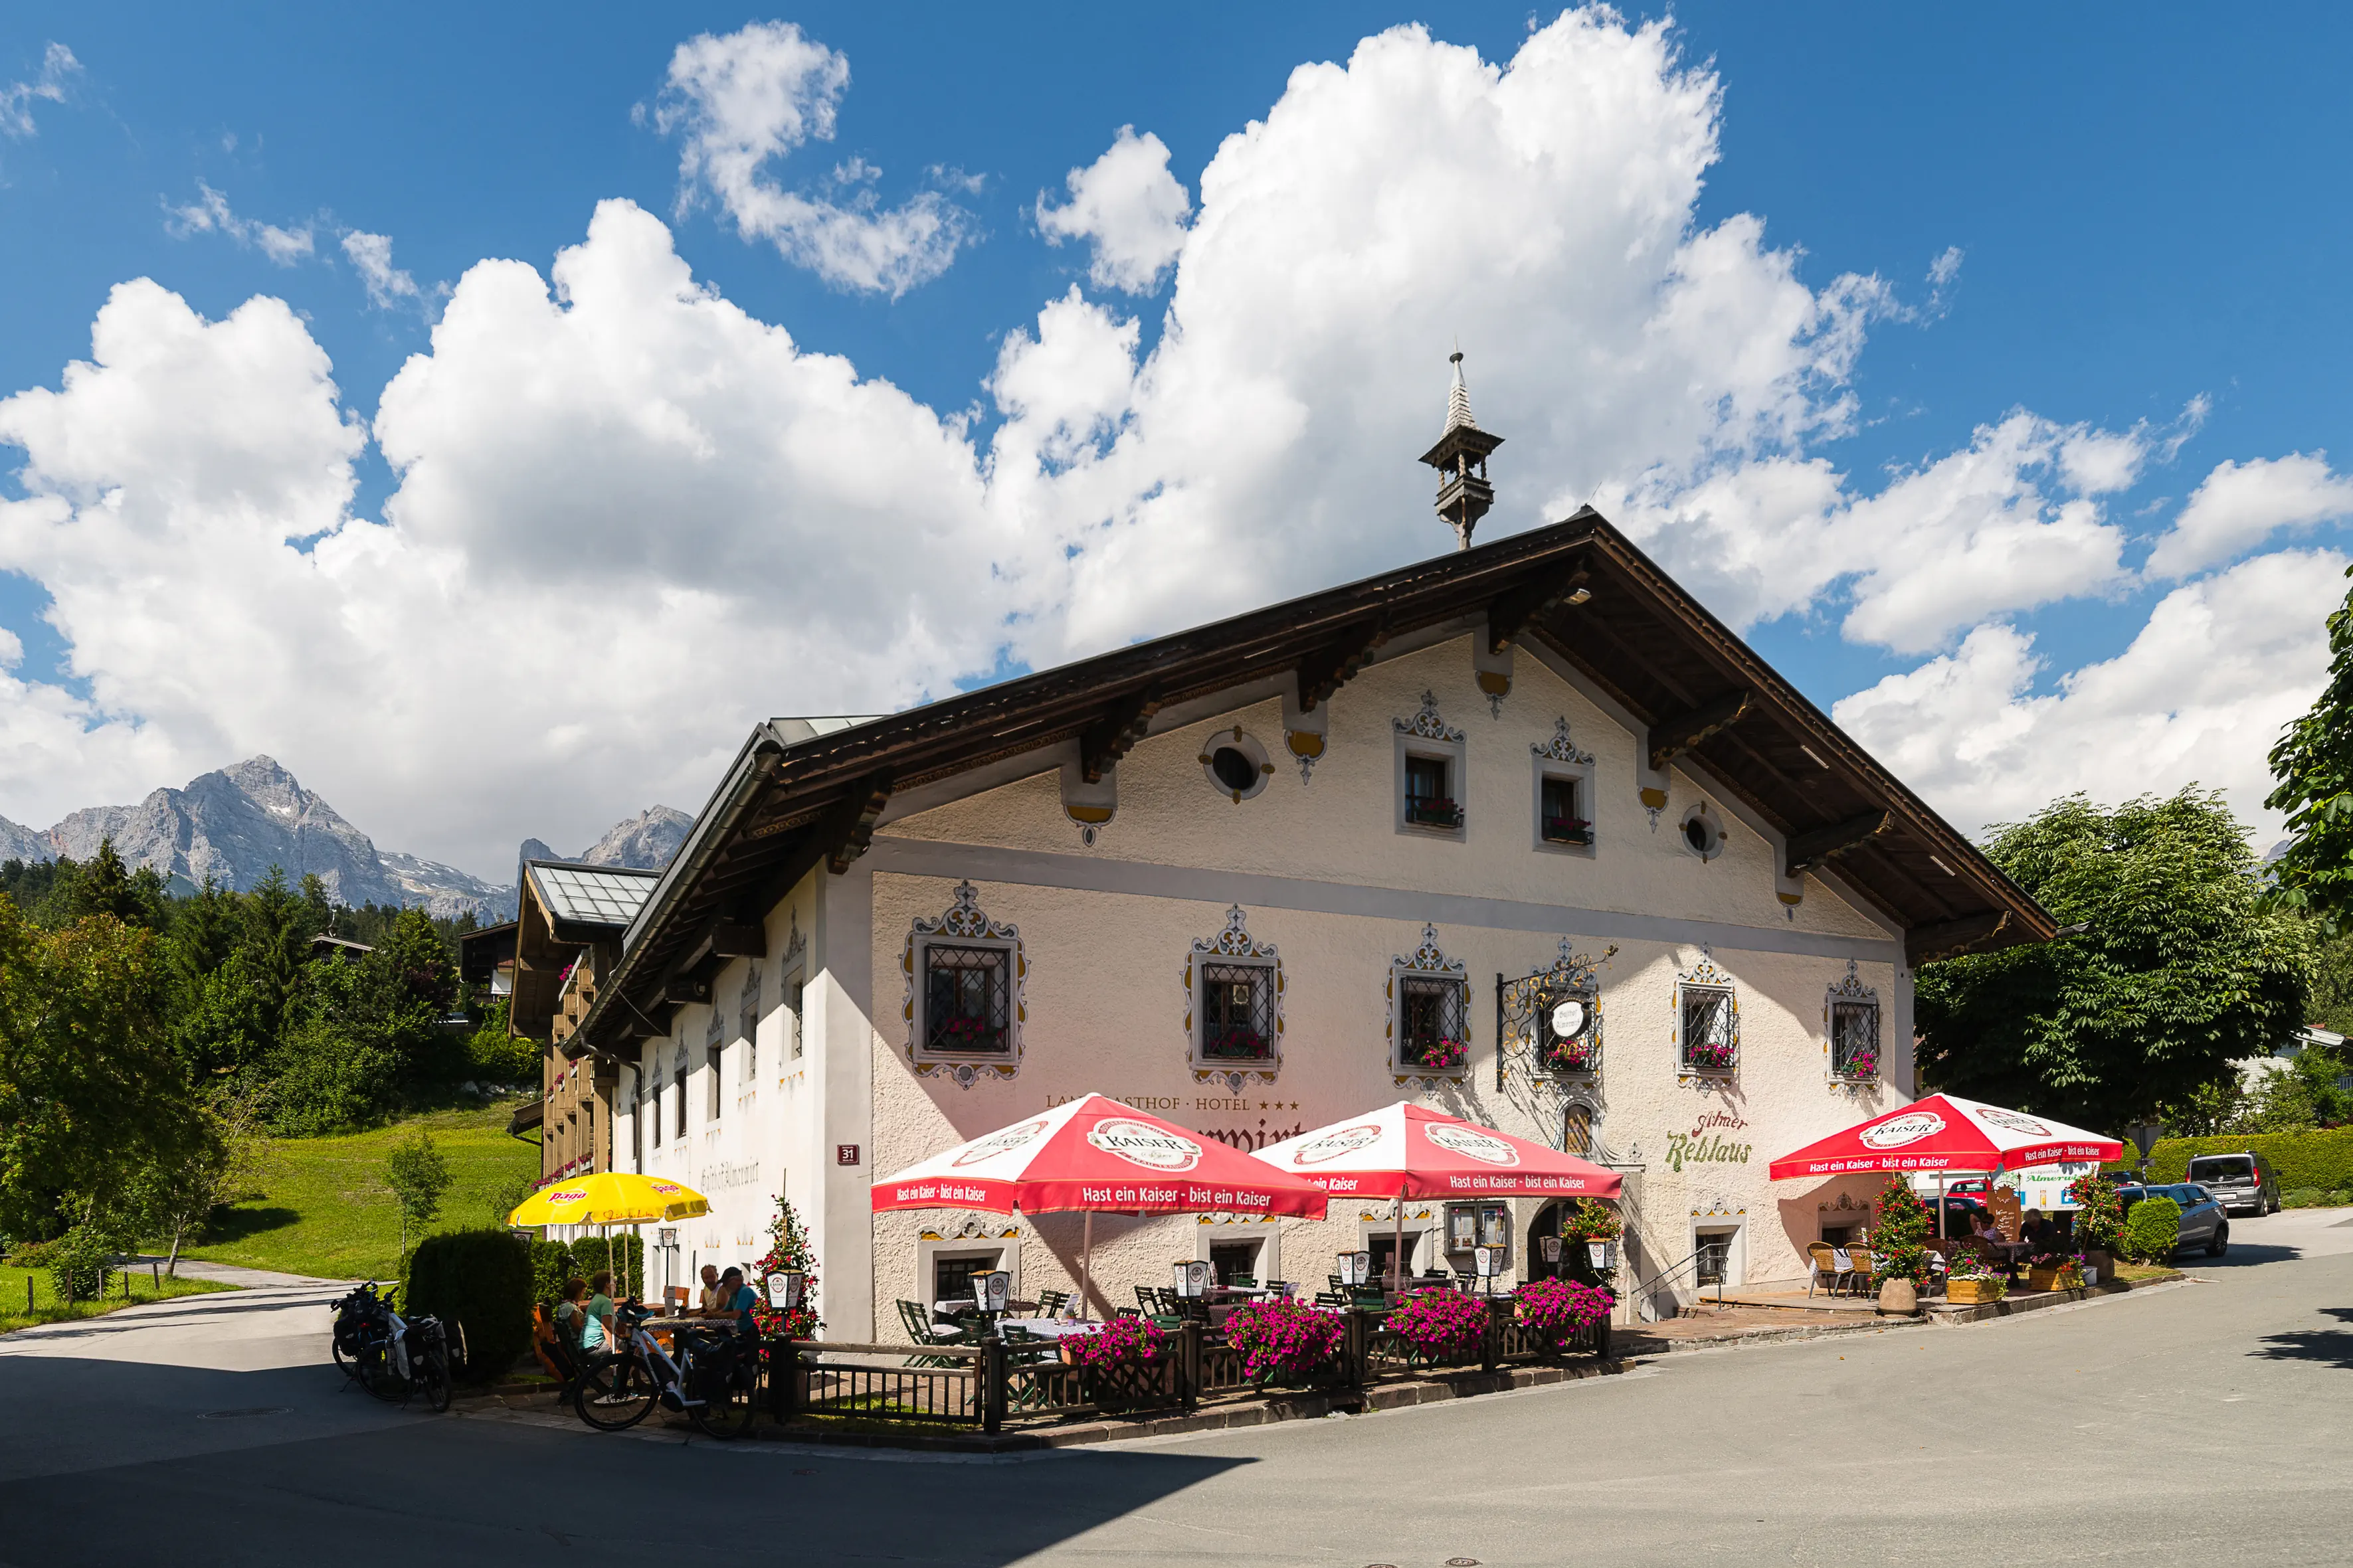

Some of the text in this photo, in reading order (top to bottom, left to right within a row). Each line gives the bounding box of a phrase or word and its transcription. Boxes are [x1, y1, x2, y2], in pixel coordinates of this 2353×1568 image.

[1196, 1098, 1250, 1110] HOTEL
[1874, 1124, 1932, 1135] KAISER
[1105, 1136, 1184, 1150] KAISER
[1440, 1136, 1501, 1148] KAISER
[842, 1149, 854, 1159] 31
[1665, 1130, 1752, 1173] Reblaus
[2025, 1150, 2037, 1161] Hast
[2037, 1149, 2047, 1159] ein
[2047, 1147, 2063, 1158] Kaiser
[2067, 1146, 2077, 1155] bist
[2085, 1146, 2099, 1156] Kaiser
[1810, 1164, 1829, 1172] Hast
[1830, 1161, 1844, 1171] ein
[1846, 1160, 1873, 1170] Kaiser
[1882, 1158, 1899, 1168] bist
[1901, 1158, 1917, 1167] ein
[1919, 1156, 1949, 1167] Kaiser
[1329, 1177, 1359, 1191] Kaiser
[1450, 1176, 1471, 1188] Hast
[1473, 1175, 1487, 1188] ein
[1490, 1175, 1517, 1188] Kaiser
[1525, 1175, 1541, 1188] bist
[1543, 1176, 1557, 1188] ein
[1559, 1176, 1585, 1189] Kaiser
[897, 1188, 909, 1201] Hast
[919, 1185, 936, 1199] Kaiser
[940, 1183, 953, 1199] bist
[953, 1185, 963, 1199] ein
[965, 1185, 986, 1201] Kaiser
[1082, 1187, 1111, 1201] Hast
[1115, 1187, 1135, 1201] ein
[1139, 1187, 1178, 1202] Kaiser
[1189, 1187, 1211, 1203] bist
[1214, 1188, 1232, 1204] ein
[1236, 1191, 1271, 1207] Kaiser
